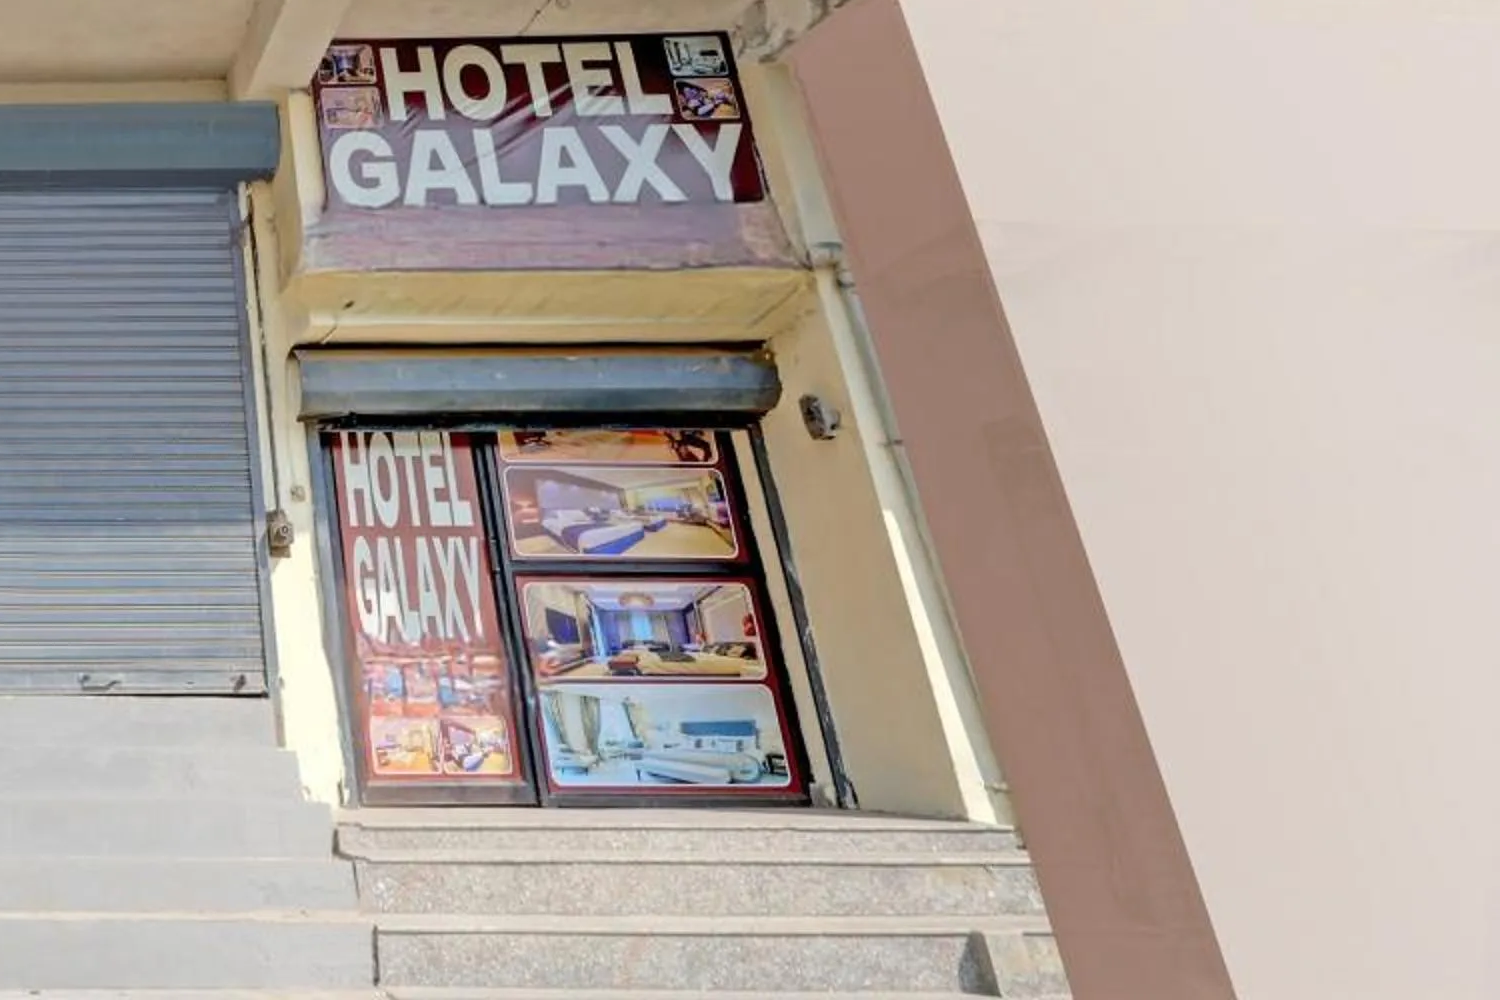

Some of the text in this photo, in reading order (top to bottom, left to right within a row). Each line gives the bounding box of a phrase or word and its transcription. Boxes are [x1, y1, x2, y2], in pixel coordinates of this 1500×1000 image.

[379, 39, 675, 122] HOTEL
[329, 122, 743, 209] GALAXY
[340, 430, 474, 529] HOTEL
[352, 534, 484, 647] GALAXY
